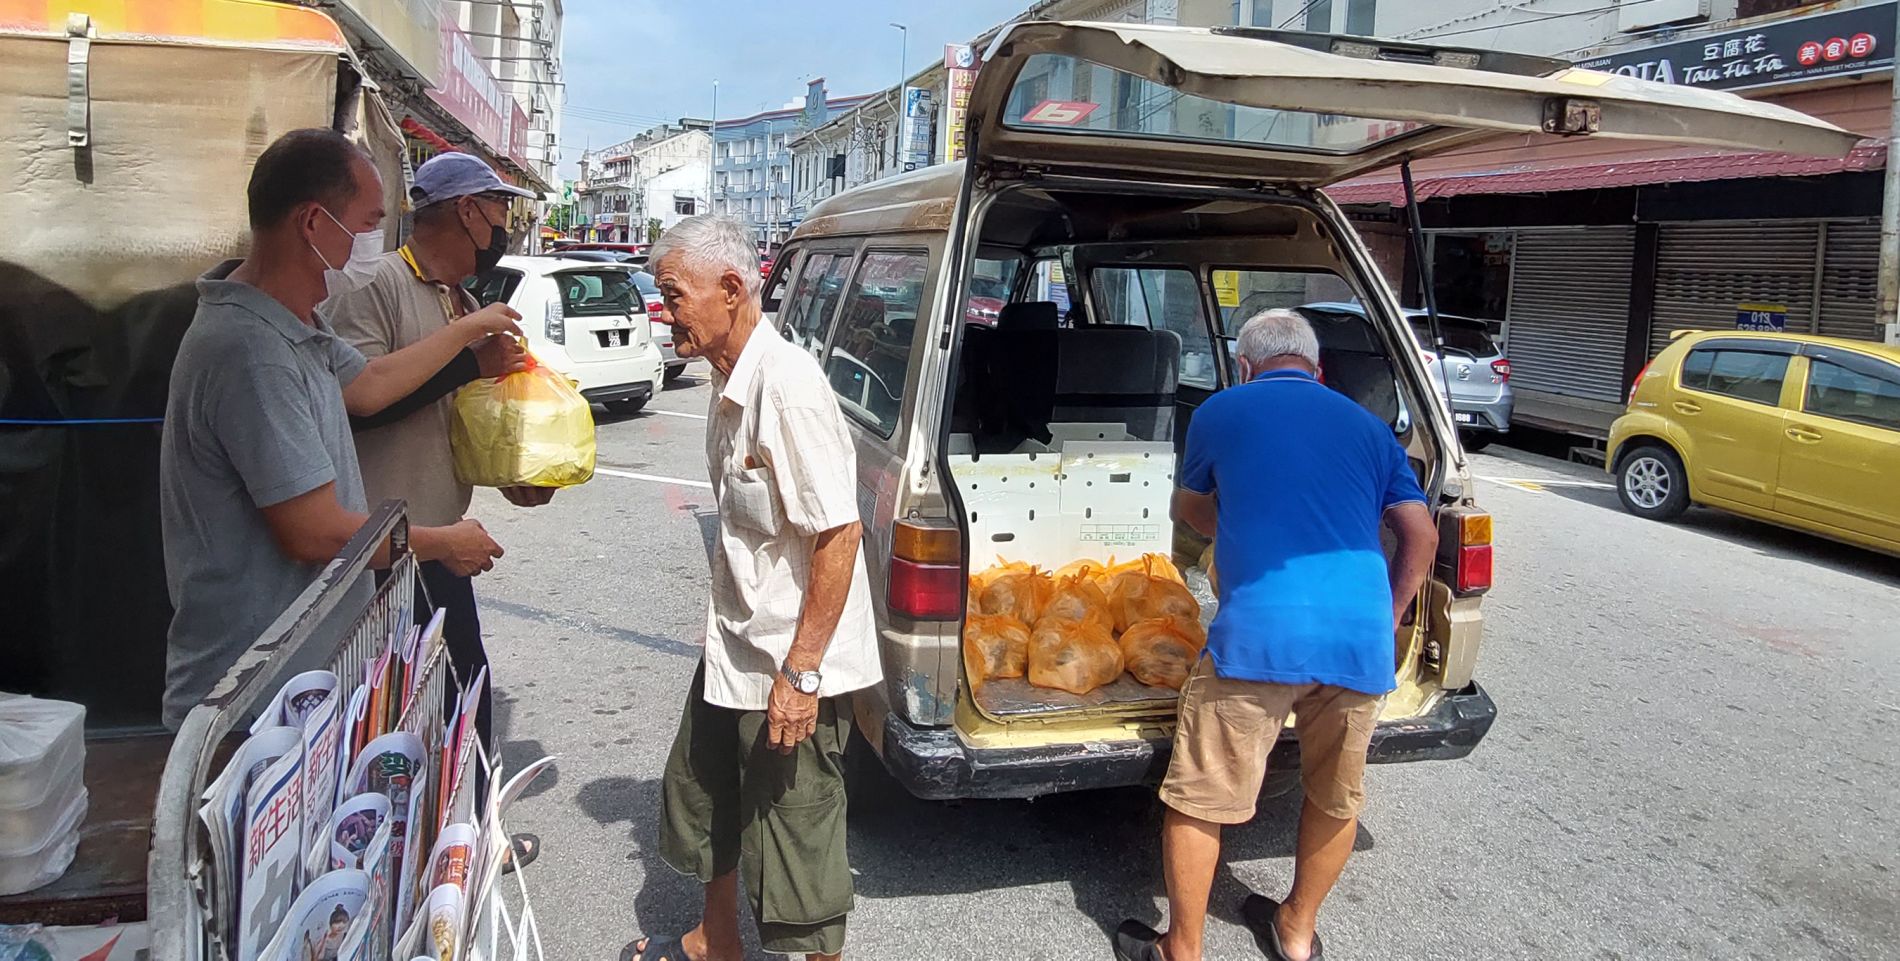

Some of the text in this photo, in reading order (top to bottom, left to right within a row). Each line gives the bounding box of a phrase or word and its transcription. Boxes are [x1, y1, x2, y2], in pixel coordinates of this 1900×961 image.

[1703, 34, 1766, 60] 豆腐花
[1800, 37, 1868, 61] 美食店
[1605, 59, 1675, 84] OTA
[1683, 54, 1787, 84] Tau Fu Fa
[308, 726, 337, 793] 新生
[249, 774, 302, 878] 新生活
